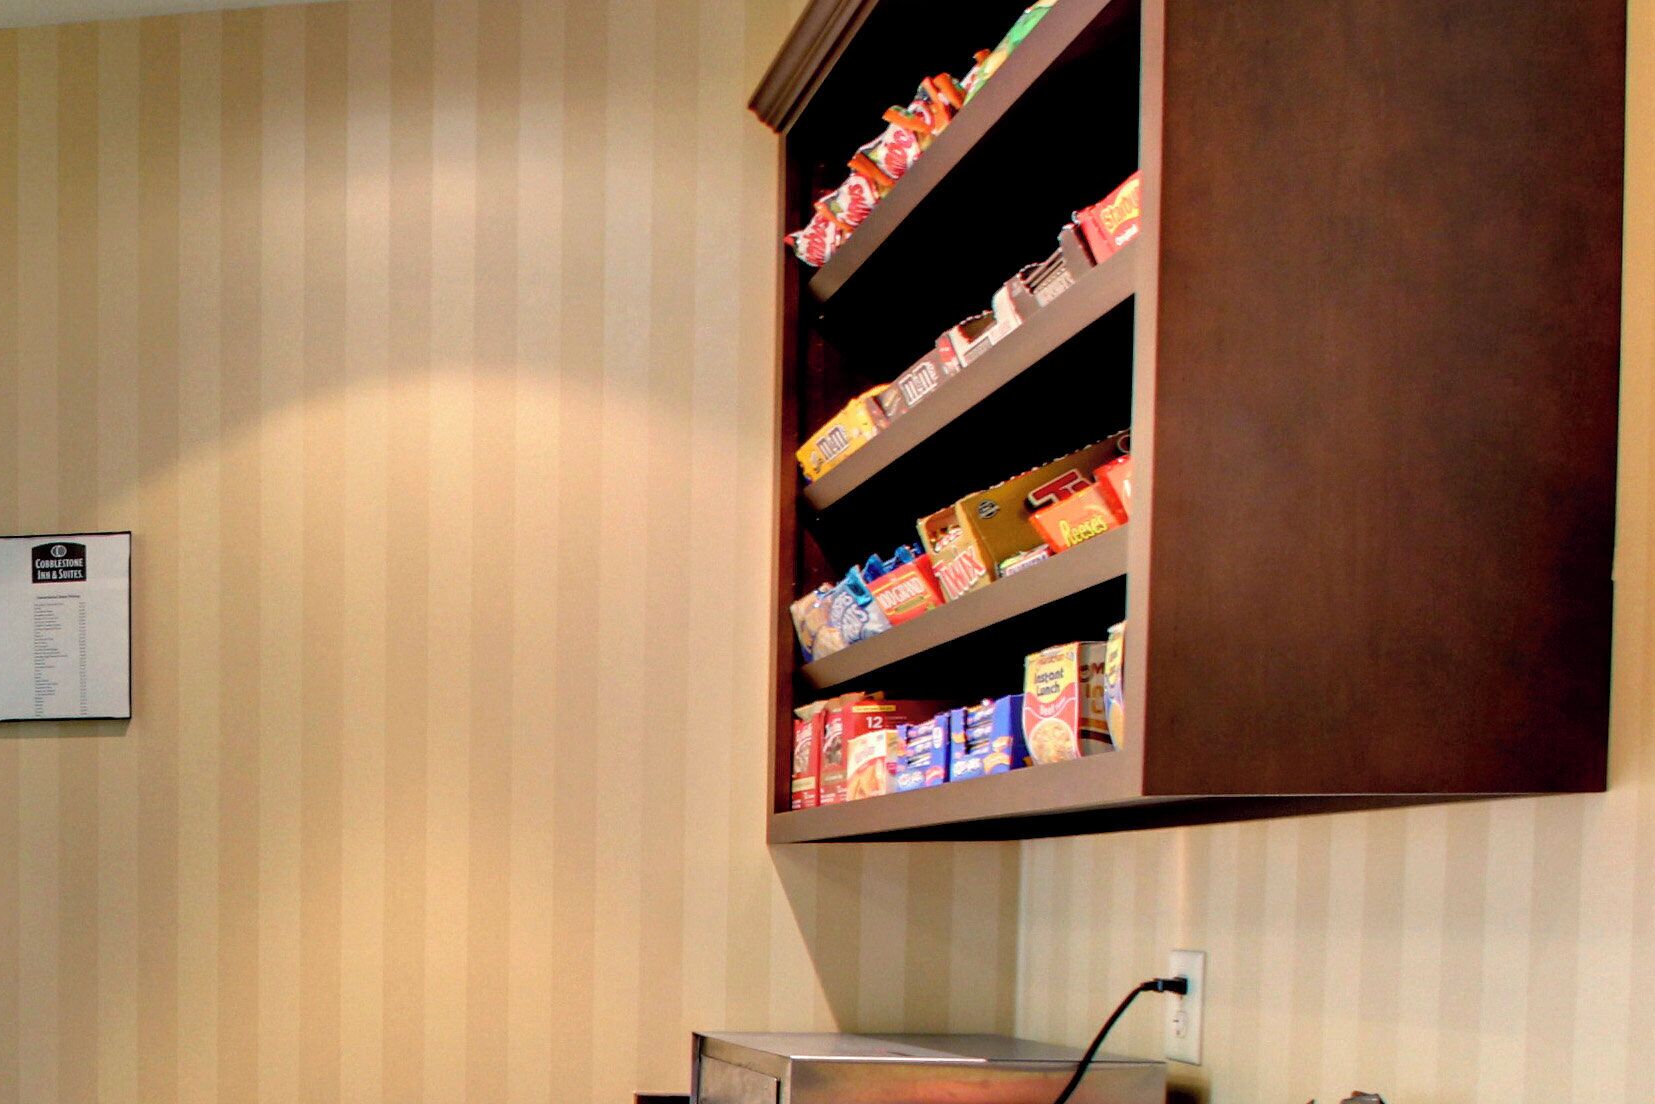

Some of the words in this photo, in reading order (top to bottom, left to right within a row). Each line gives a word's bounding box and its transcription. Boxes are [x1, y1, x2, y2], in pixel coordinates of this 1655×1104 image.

[35, 558, 84, 569] COBBLESTONE
[37, 570, 50, 580] INN
[51, 570, 58, 580] &
[58, 569, 83, 579] SUITES
[933, 546, 986, 600] TWIX
[1035, 668, 1063, 684] Instant
[1036, 682, 1061, 697] Lunch
[866, 716, 884, 729] 12
